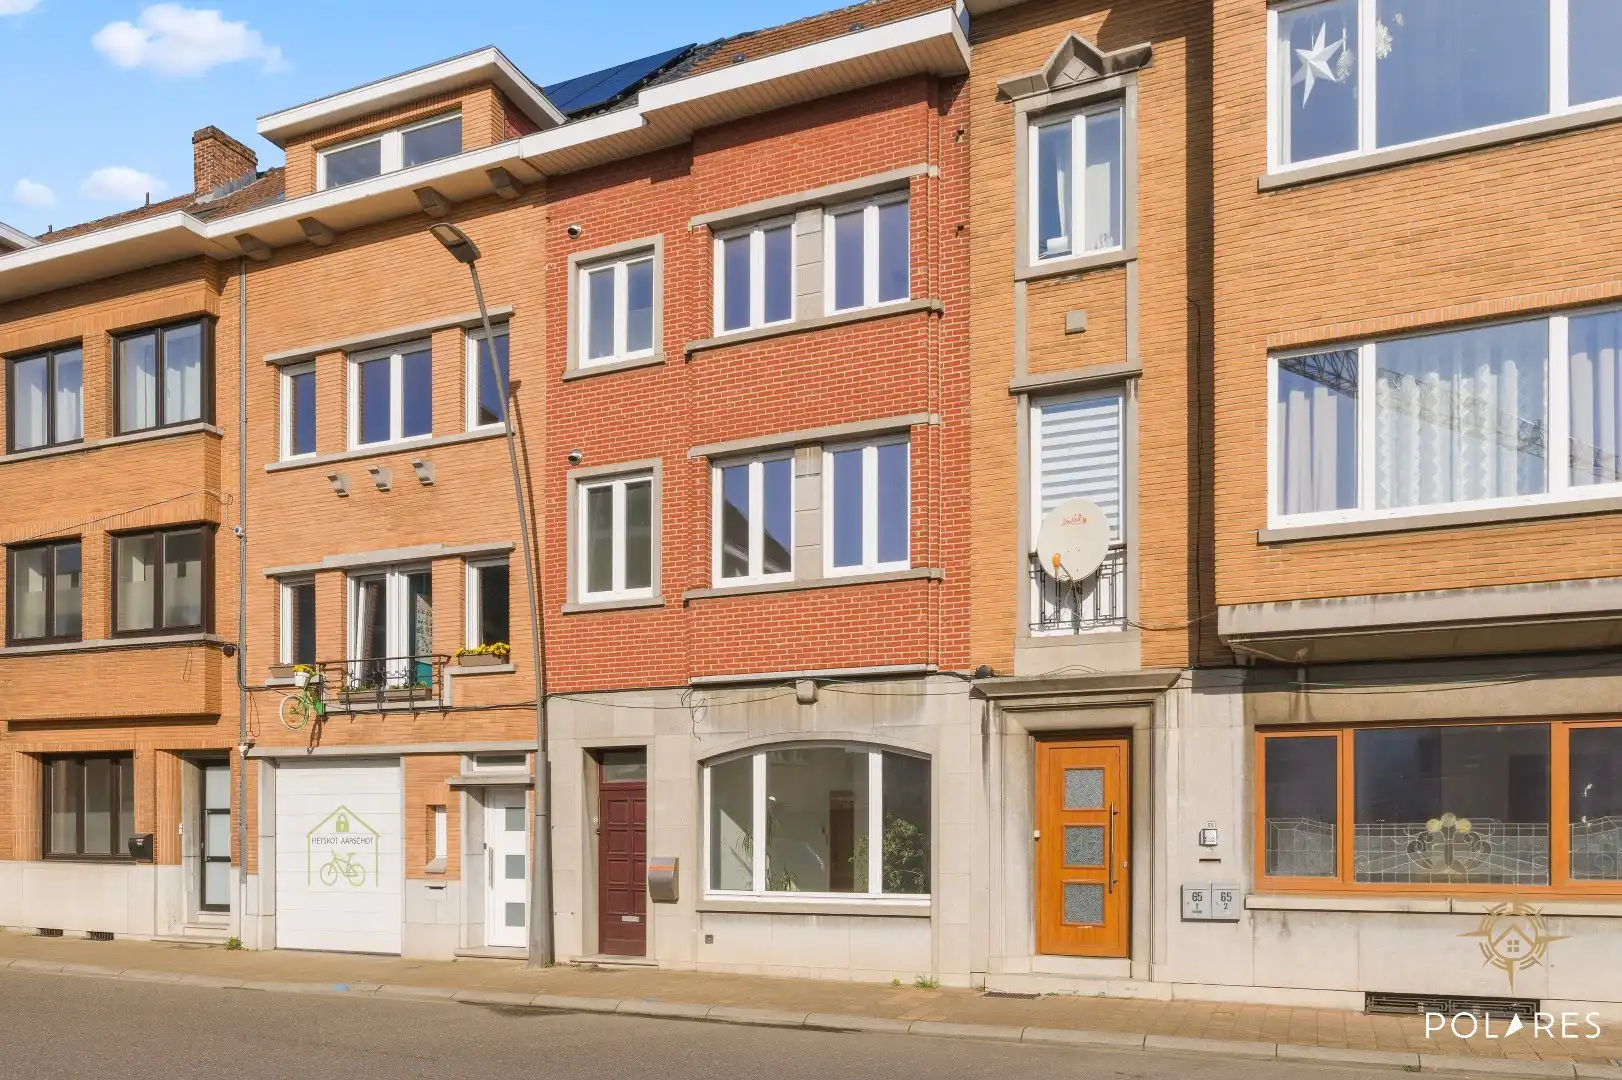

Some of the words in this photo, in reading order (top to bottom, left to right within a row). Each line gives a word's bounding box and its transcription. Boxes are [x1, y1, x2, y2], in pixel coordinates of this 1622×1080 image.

[311, 837, 338, 845] FIETSKOT
[340, 837, 373, 845] AARSCHOT
[1191, 891, 1203, 902] 65
[1220, 891, 1232, 902] 65
[1223, 902, 1228, 910] 2
